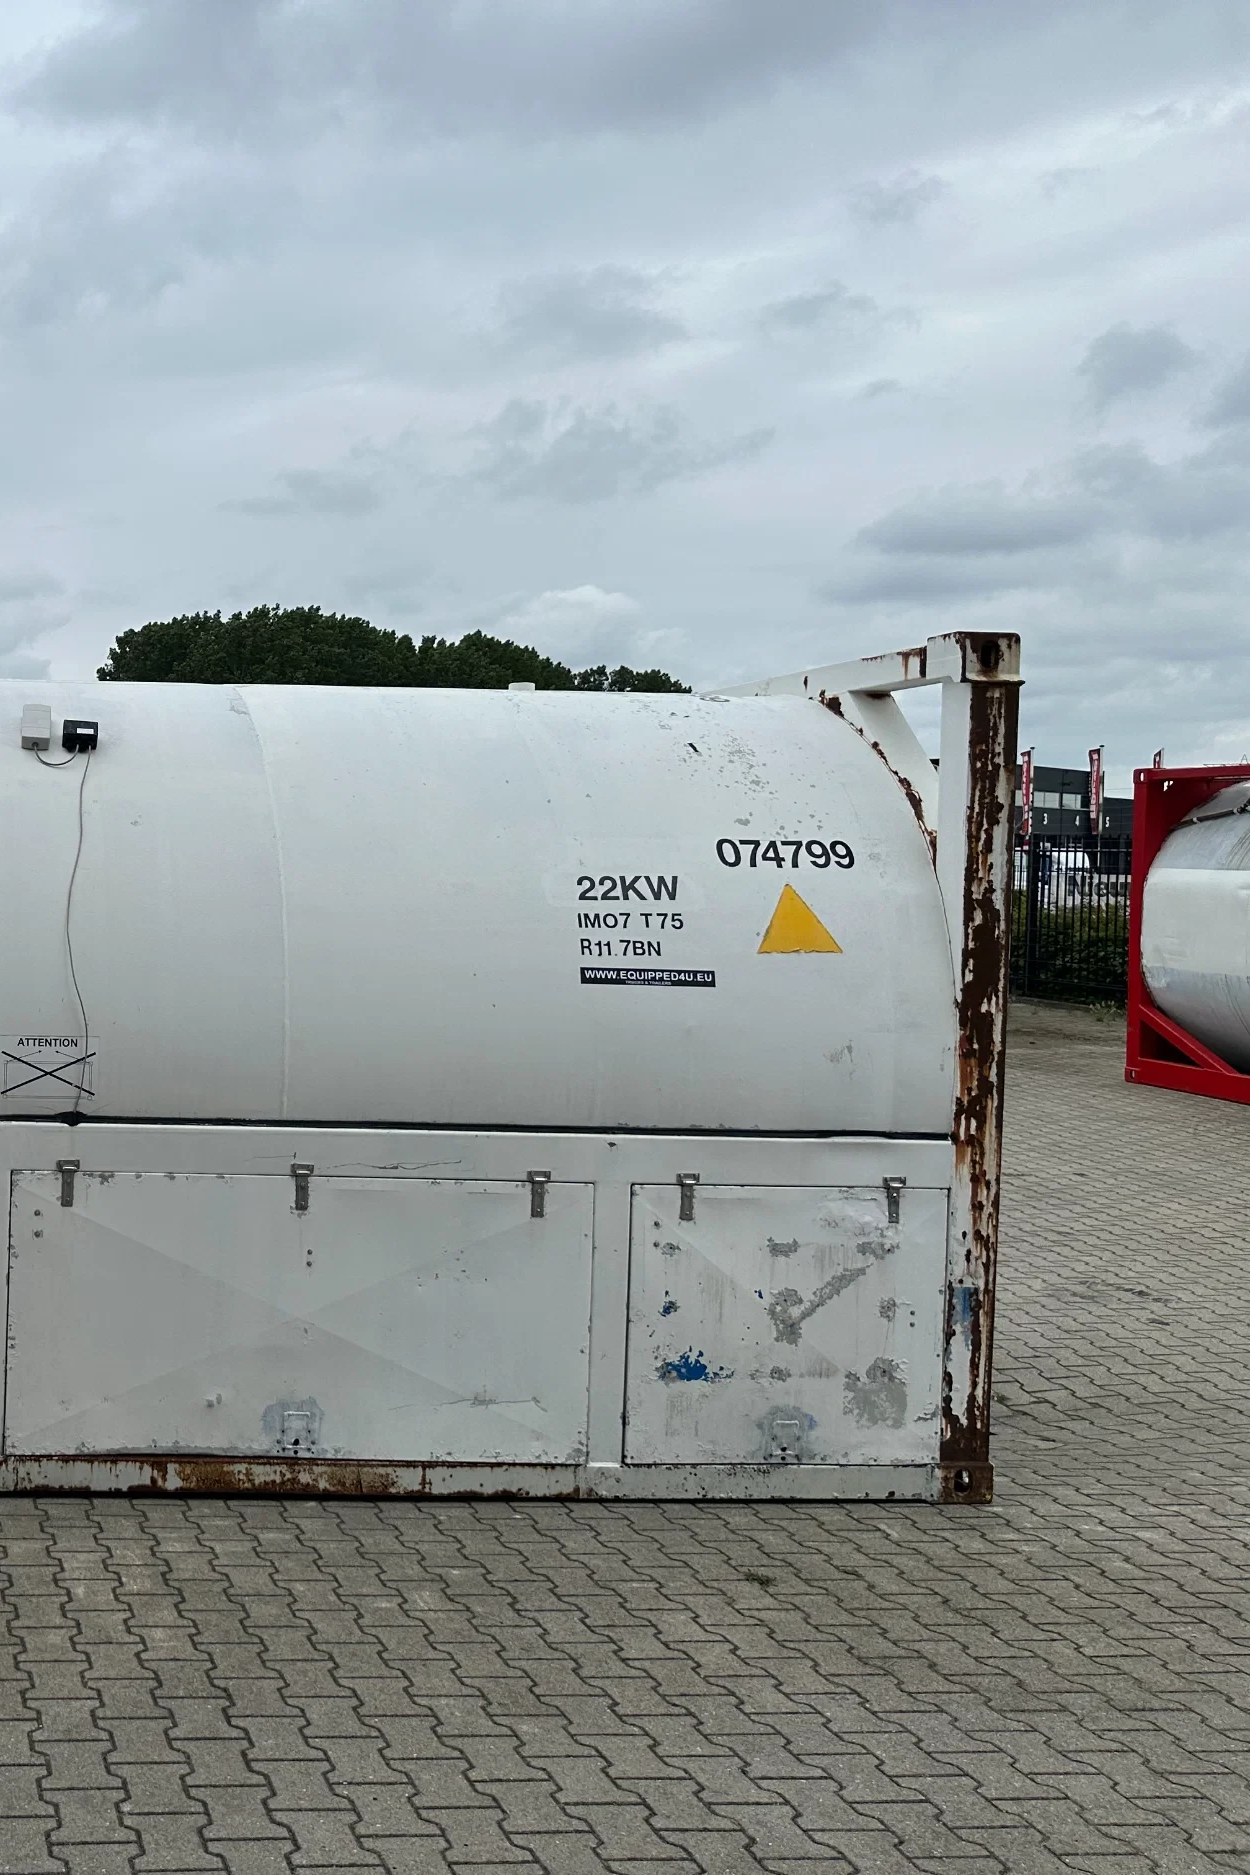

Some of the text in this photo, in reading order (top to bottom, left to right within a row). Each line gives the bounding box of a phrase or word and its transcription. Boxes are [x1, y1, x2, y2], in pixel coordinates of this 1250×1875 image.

[1043, 813, 1048, 825] 3
[1075, 815, 1080, 826] 4
[1105, 816, 1110, 828] 5
[715, 838, 856, 869] 074799
[576, 875, 679, 901] 22KW
[577, 912, 684, 930] IMO7 T75
[579, 938, 662, 957] R11.7BN
[584, 969, 712, 982] WWW.EQUIPPED4U.EU
[16, 1037, 79, 1048] ATTENTION
